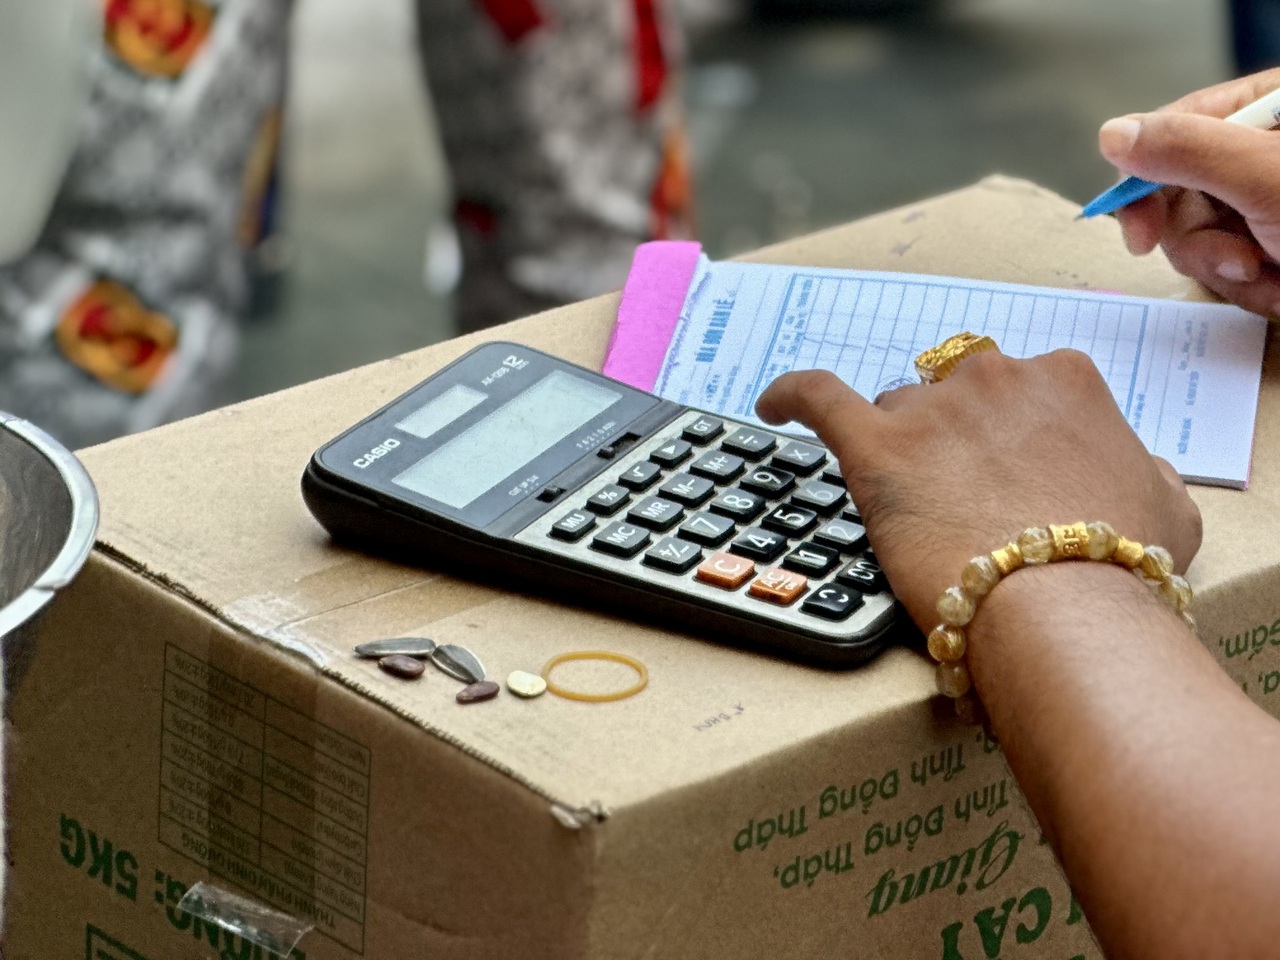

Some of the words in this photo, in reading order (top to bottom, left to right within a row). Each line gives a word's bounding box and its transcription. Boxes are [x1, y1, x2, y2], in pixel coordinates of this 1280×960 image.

[692, 419, 712, 433] GT
[352, 438, 401, 469] CASIO
[752, 470, 781, 485] 9
[568, 512, 586, 529] MU
[648, 500, 670, 519] MR
[689, 517, 720, 533] 7
[774, 508, 805, 526] 5
[722, 494, 755, 510] 8
[807, 487, 834, 502] 6
[606, 526, 636, 544] MC
[754, 532, 777, 548] 4
[827, 525, 859, 540] 2
[713, 559, 741, 575] C
[798, 549, 828, 566] 1
[910, 742, 966, 787] Tỉnh
[818, 767, 900, 820] Đồng
[954, 779, 1010, 821] Tỉnh
[733, 804, 808, 853] Tháp
[864, 803, 944, 856] Đồng
[60, 813, 138, 902] 5KG
[773, 840, 855, 889] Tháp,
[865, 820, 1026, 919] Giang
